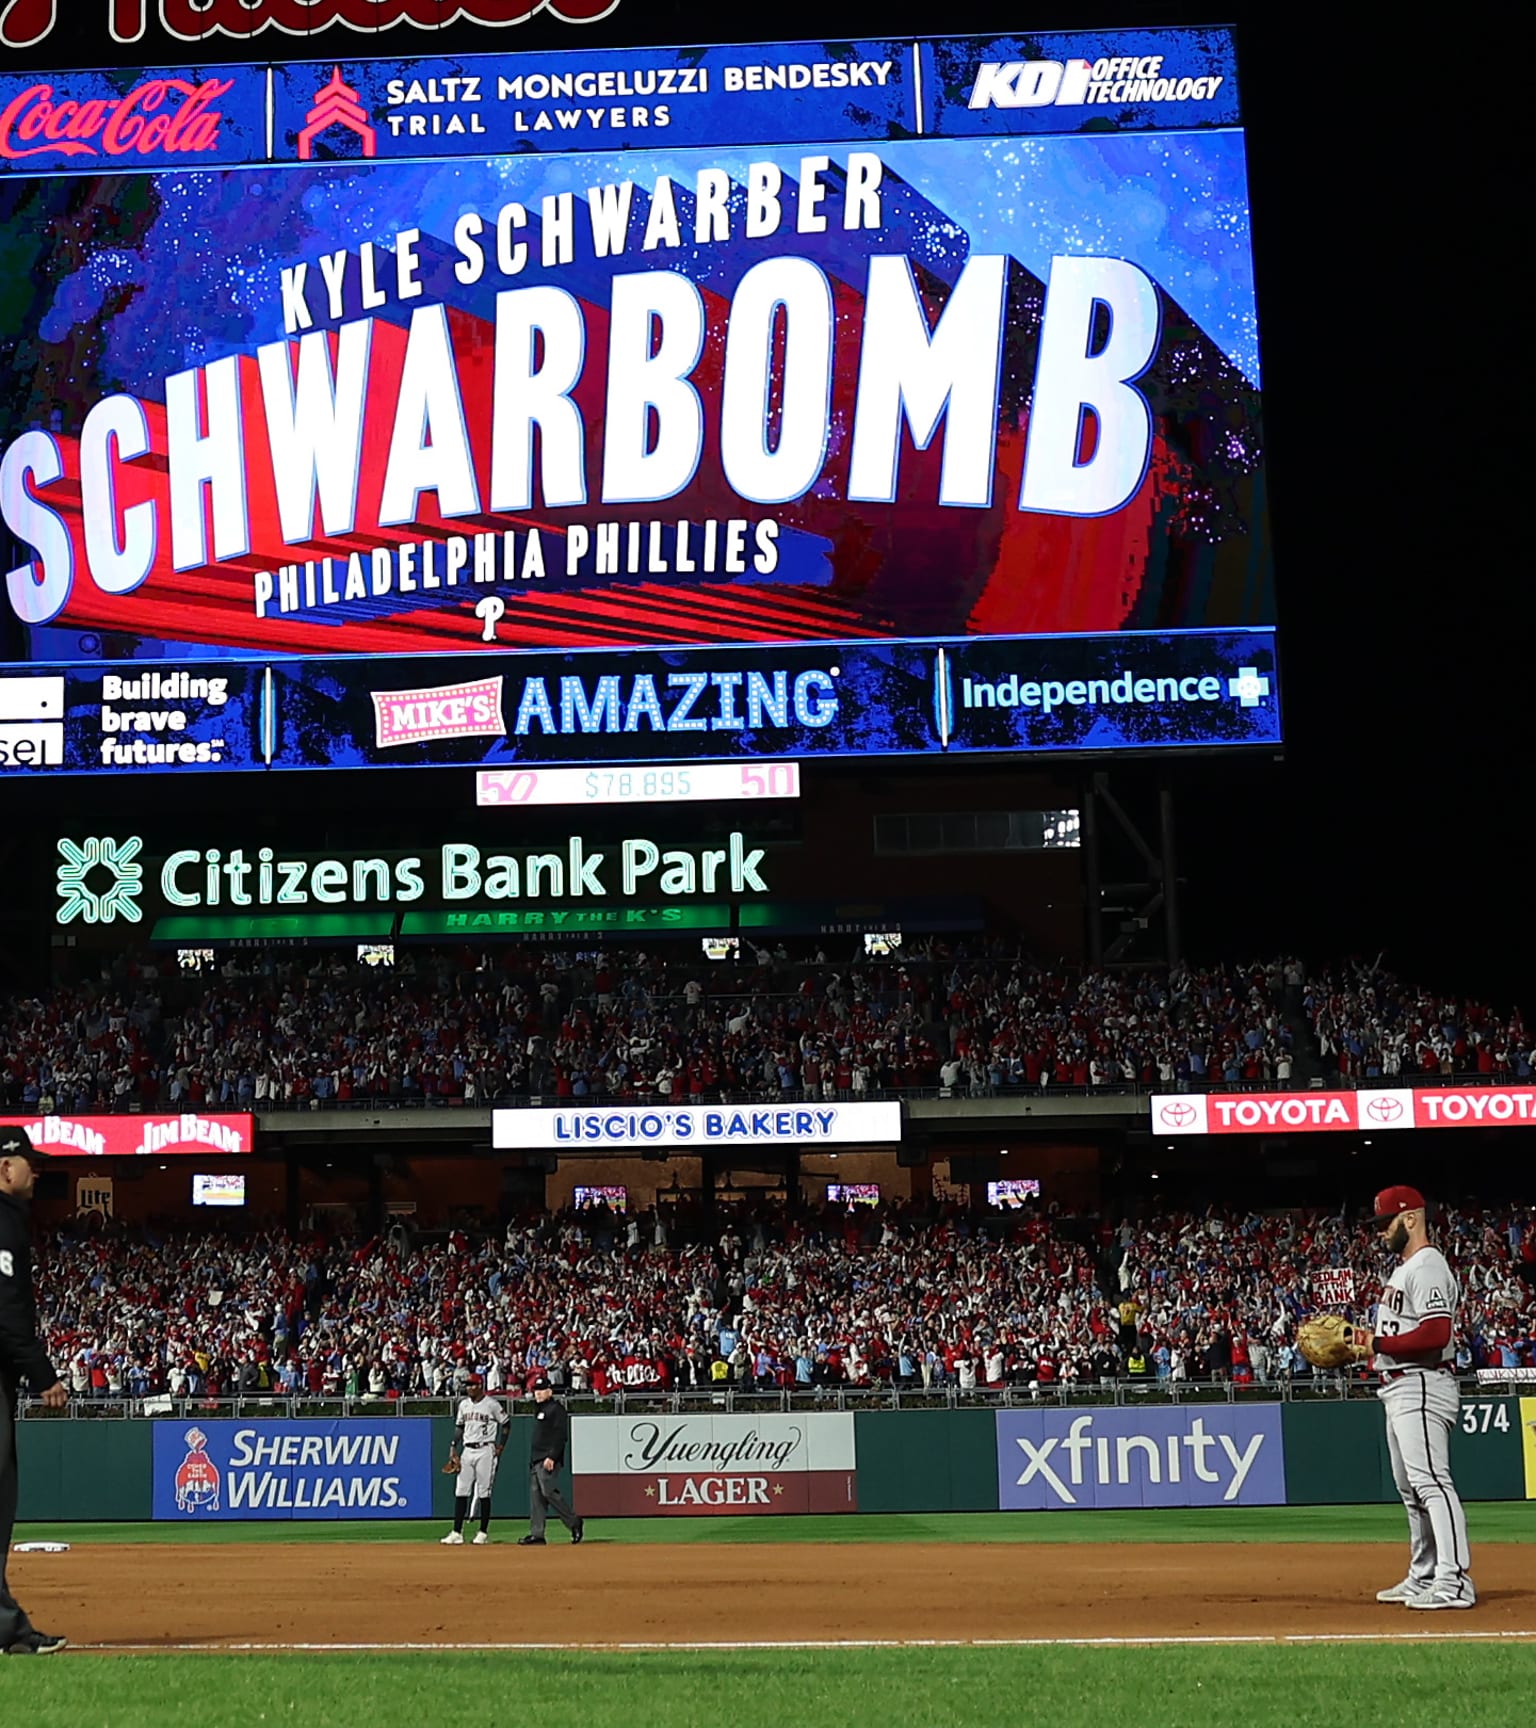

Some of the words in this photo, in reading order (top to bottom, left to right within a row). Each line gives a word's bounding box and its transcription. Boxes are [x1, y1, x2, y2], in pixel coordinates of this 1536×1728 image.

[386, 77, 480, 104] SALTZ
[498, 67, 708, 101] MONGELUZZI
[724, 61, 892, 92] BENDESKY
[967, 59, 1092, 109] KDI
[1091, 56, 1163, 80] OFFICE
[1087, 76, 1223, 104] TECHNOLOGY
[388, 113, 485, 136] TRIAL
[515, 105, 670, 134] LAWYERS
[280, 229, 422, 333] KYLE
[453, 152, 883, 285] SCHWARBER
[254, 528, 545, 618] PHILADELPHIA
[566, 518, 779, 576] PHILLIES
[102, 672, 228, 705] Building
[391, 694, 492, 731] MIKE'S
[514, 669, 839, 735] AMAZING
[964, 671, 1220, 713] Independence
[101, 705, 187, 732] brave
[741, 765, 794, 796] 50
[162, 848, 423, 907] Citizens
[442, 836, 607, 899] Bank
[622, 832, 769, 894] Park
[445, 911, 569, 928] HARRY
[576, 912, 617, 921] THE
[626, 908, 682, 922] K'S
[1215, 1098, 1350, 1126] TOYOTA
[1422, 1093, 1536, 1121] TOYOT
[43, 1116, 107, 1155] BEAM
[136, 1121, 182, 1155] JIM
[180, 1114, 243, 1153] BEAM
[555, 1114, 692, 1140] LISCIO'S
[705, 1111, 835, 1136] BAKERY
[80, 1189, 111, 1209] Lite
[1313, 1288, 1354, 1304] BANK
[1463, 1404, 1510, 1433] 374
[229, 1429, 399, 1466] SHERWIN
[625, 1422, 802, 1470] Yuengling
[1016, 1415, 1264, 1504] xfinity
[228, 1471, 400, 1508] WILLIAMS
[658, 1477, 771, 1505] LAGER
